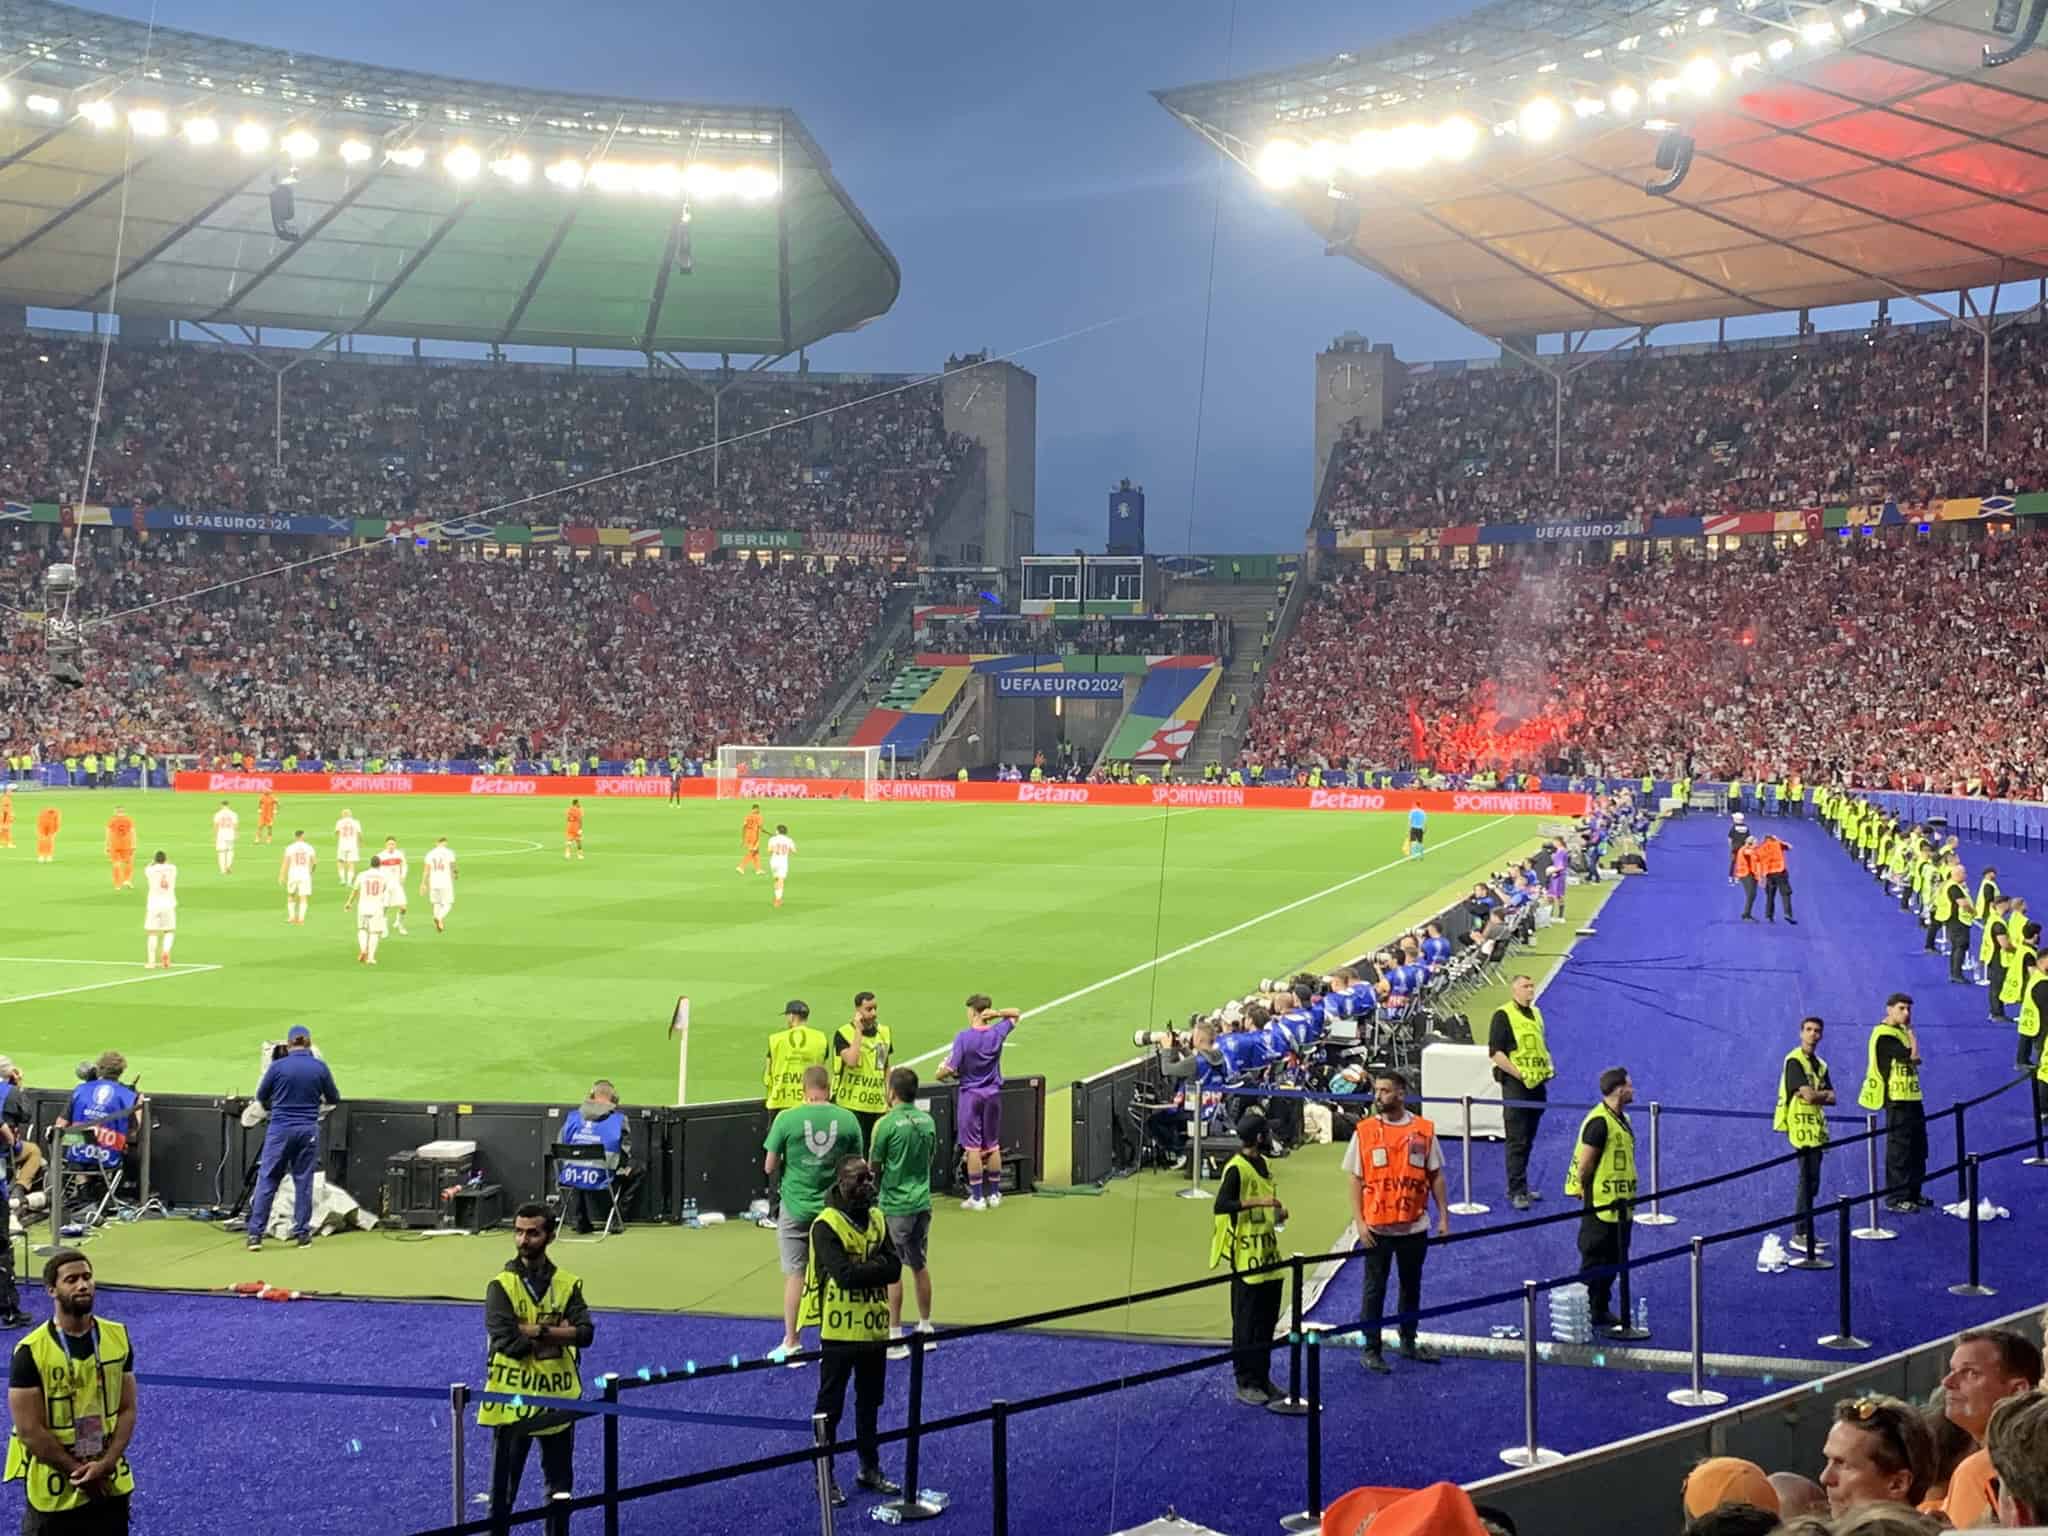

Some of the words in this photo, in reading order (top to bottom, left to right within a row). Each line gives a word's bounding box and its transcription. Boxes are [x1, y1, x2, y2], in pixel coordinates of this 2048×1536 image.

[722, 534, 788, 545] BERLIN
[595, 779, 671, 796] SPORTWETTE
[1018, 785, 1088, 801] Betano
[1152, 787, 1244, 804] SPORTWETTEN
[1310, 790, 1385, 809] Betano
[1453, 796, 1552, 811] SPORTWETTEN
